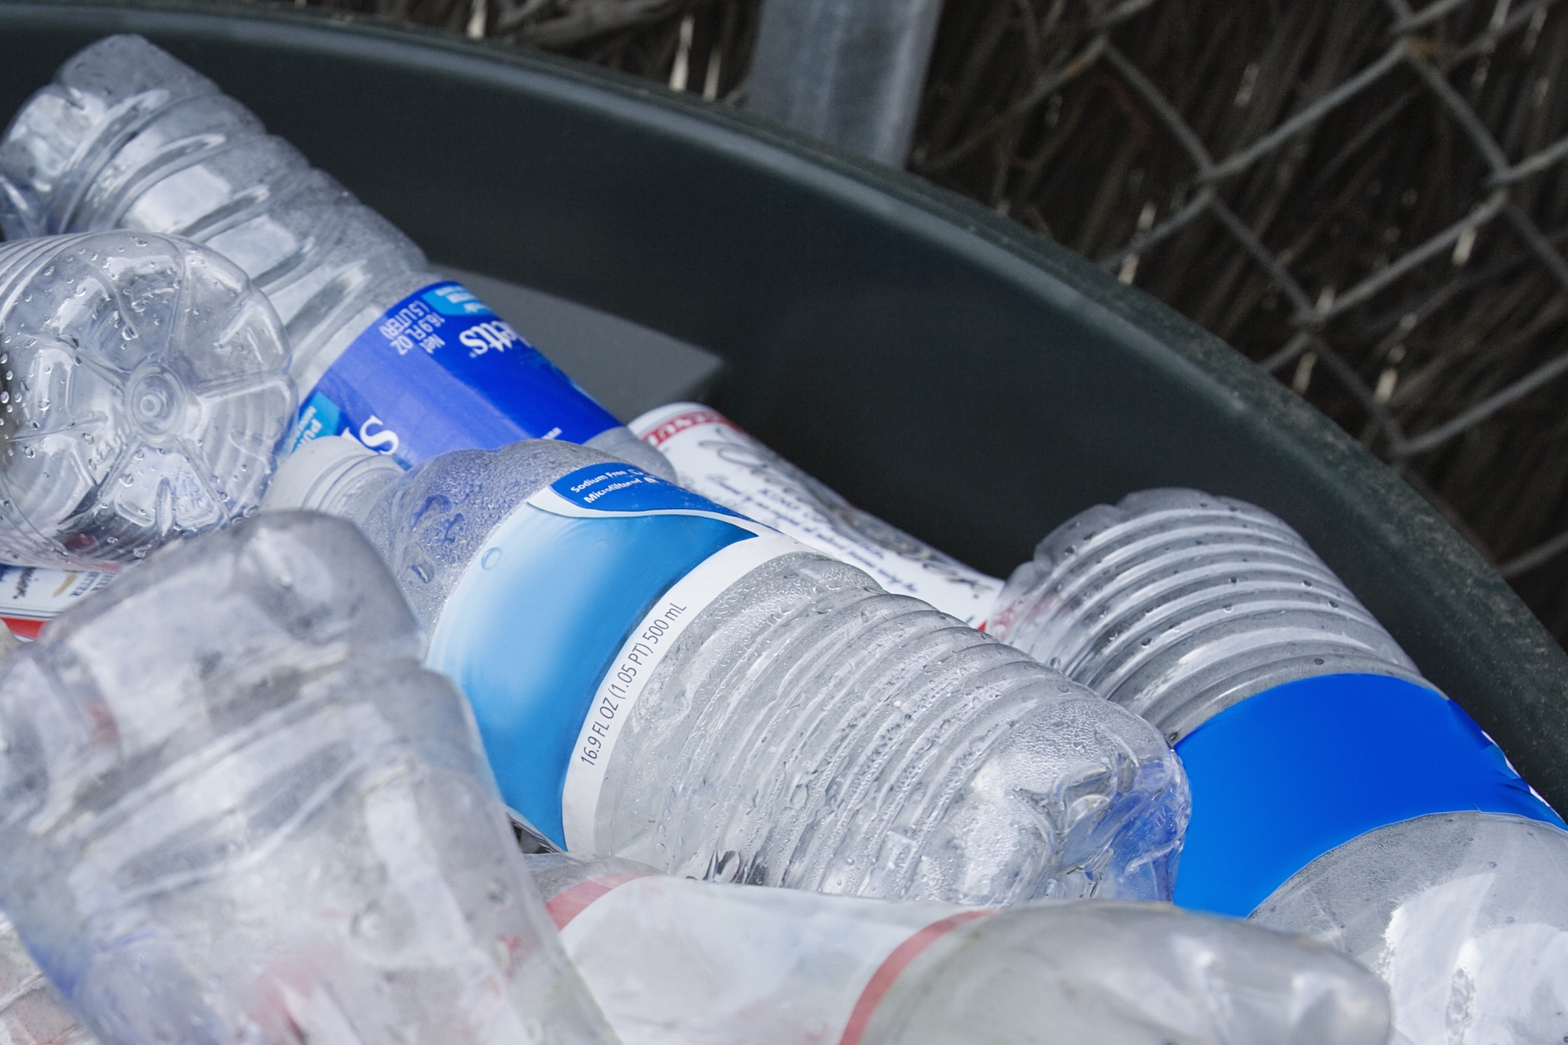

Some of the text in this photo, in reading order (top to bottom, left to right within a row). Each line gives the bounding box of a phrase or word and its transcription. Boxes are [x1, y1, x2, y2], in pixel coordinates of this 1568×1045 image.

[378, 308, 418, 339] LITER)
[390, 312, 445, 356] 16.9 FL OZ
[419, 333, 445, 354] Net
[570, 474, 609, 493] Sodium
[581, 602, 687, 766] 16.9 FL OZ (1.05 PT) 500 mL
